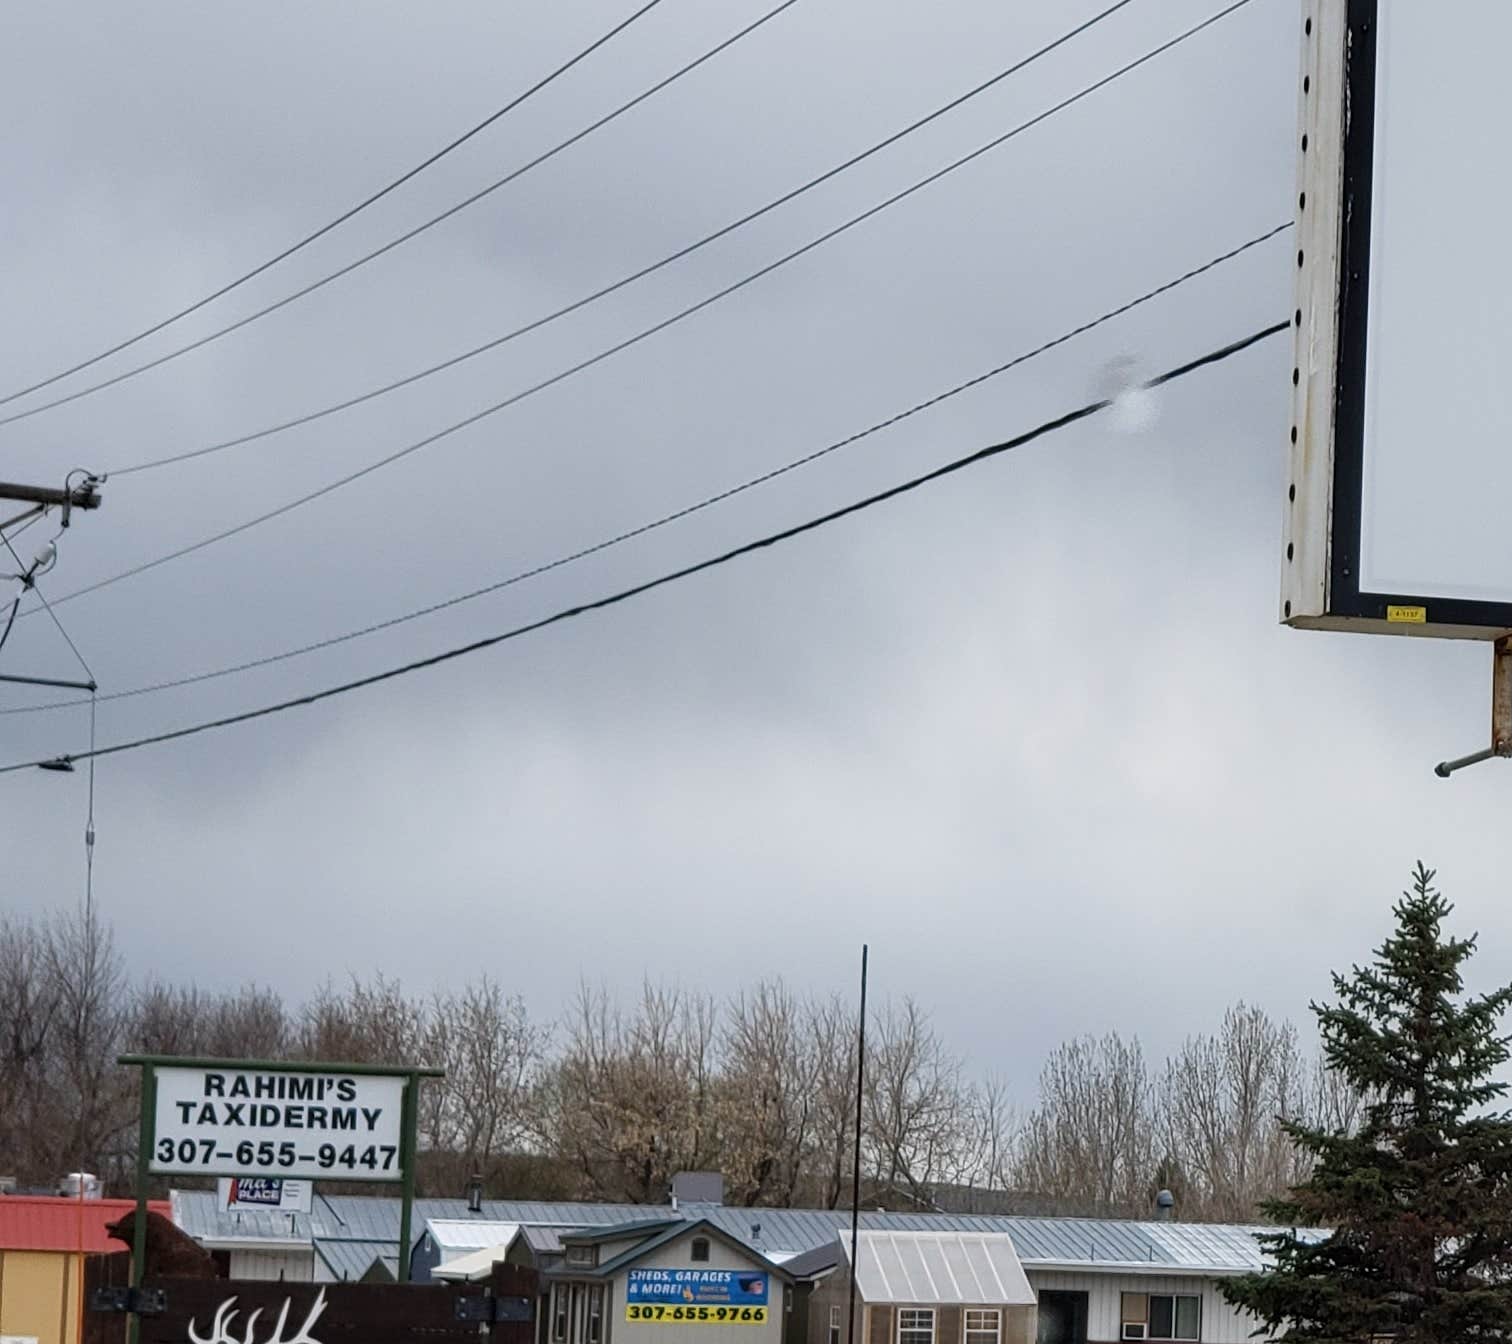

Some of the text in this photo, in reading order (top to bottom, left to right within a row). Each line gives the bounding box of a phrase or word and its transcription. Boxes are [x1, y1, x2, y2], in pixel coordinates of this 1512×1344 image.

[203, 1074, 358, 1102] RAHIMI'S
[175, 1101, 383, 1131] TAXIDERMY
[157, 1138, 397, 1170] 307-655-9447
[239, 1190, 280, 1200] PLACE
[629, 1270, 732, 1282] SHEDS, GARAGES
[629, 1283, 682, 1294] & MORE!
[629, 1306, 764, 1321] 307-655-9766
